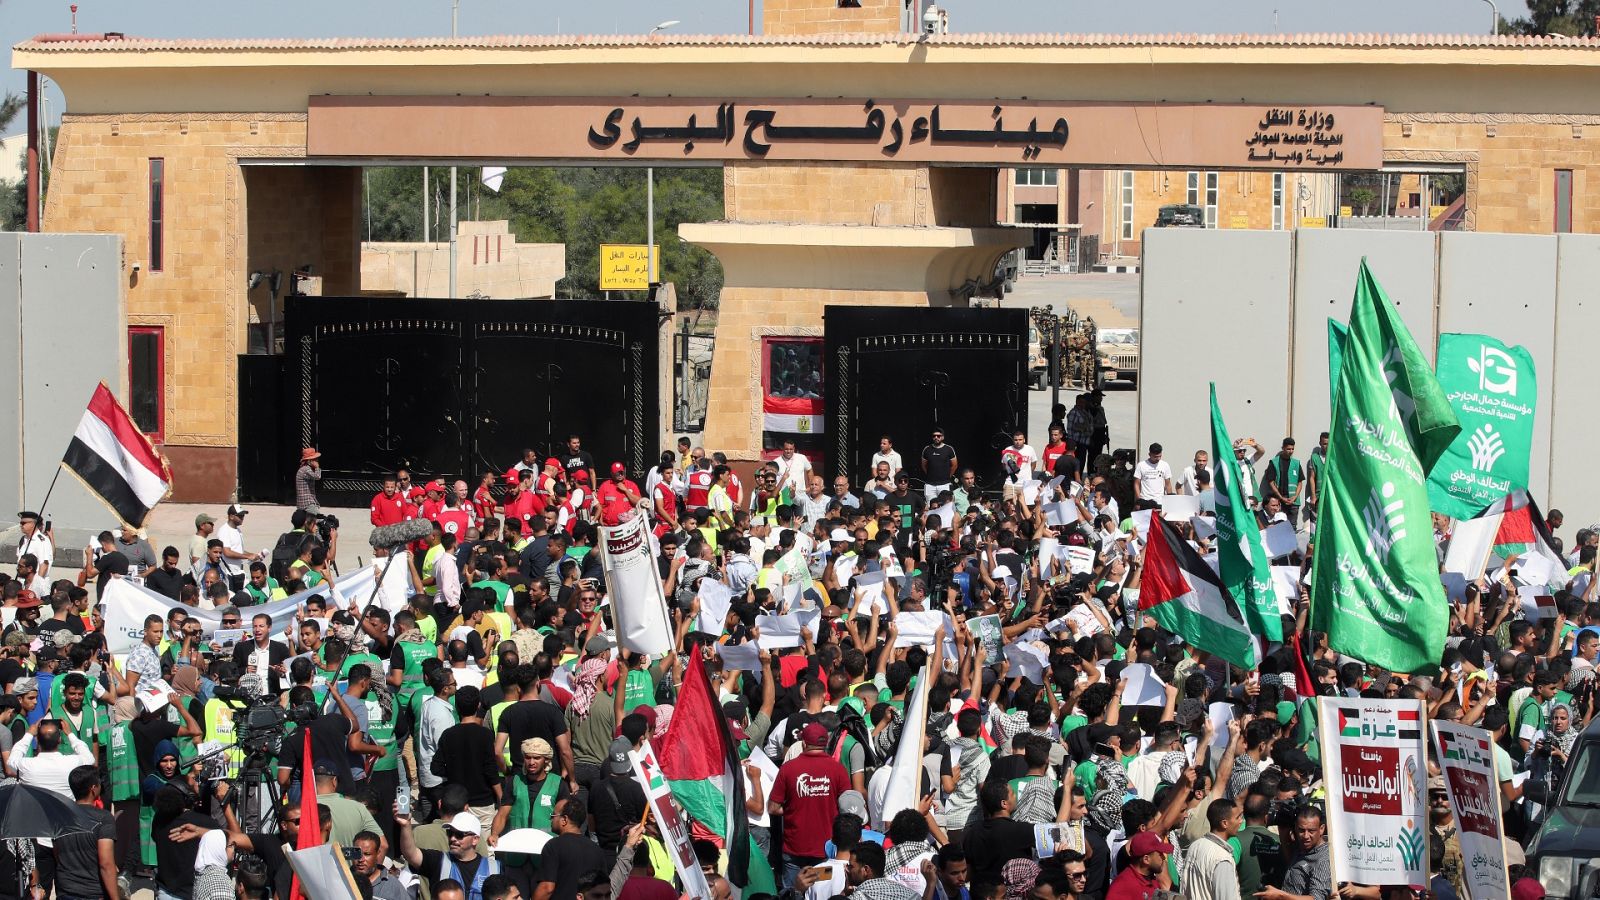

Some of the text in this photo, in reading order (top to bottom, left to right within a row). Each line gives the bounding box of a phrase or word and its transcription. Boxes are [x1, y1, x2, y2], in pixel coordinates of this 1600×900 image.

[1259, 108, 1334, 130] وزارة النقل
[743, 98, 901, 157] رفح
[911, 104, 1070, 160] ميناء
[1282, 132, 1312, 146] العامة
[1313, 132, 1343, 148] الهيئة
[1306, 149, 1343, 165] البرية
[1462, 403, 1496, 416] المجتمعية
[1478, 395, 1501, 408] جمال
[1501, 398, 1532, 416] مؤسسة
[1477, 476, 1510, 493] التحالف
[1362, 717, 1396, 741] غزة
[1360, 748, 1383, 763] مؤسسة
[1458, 742, 1483, 765] غزة
[1366, 835, 1393, 848] التحالف
